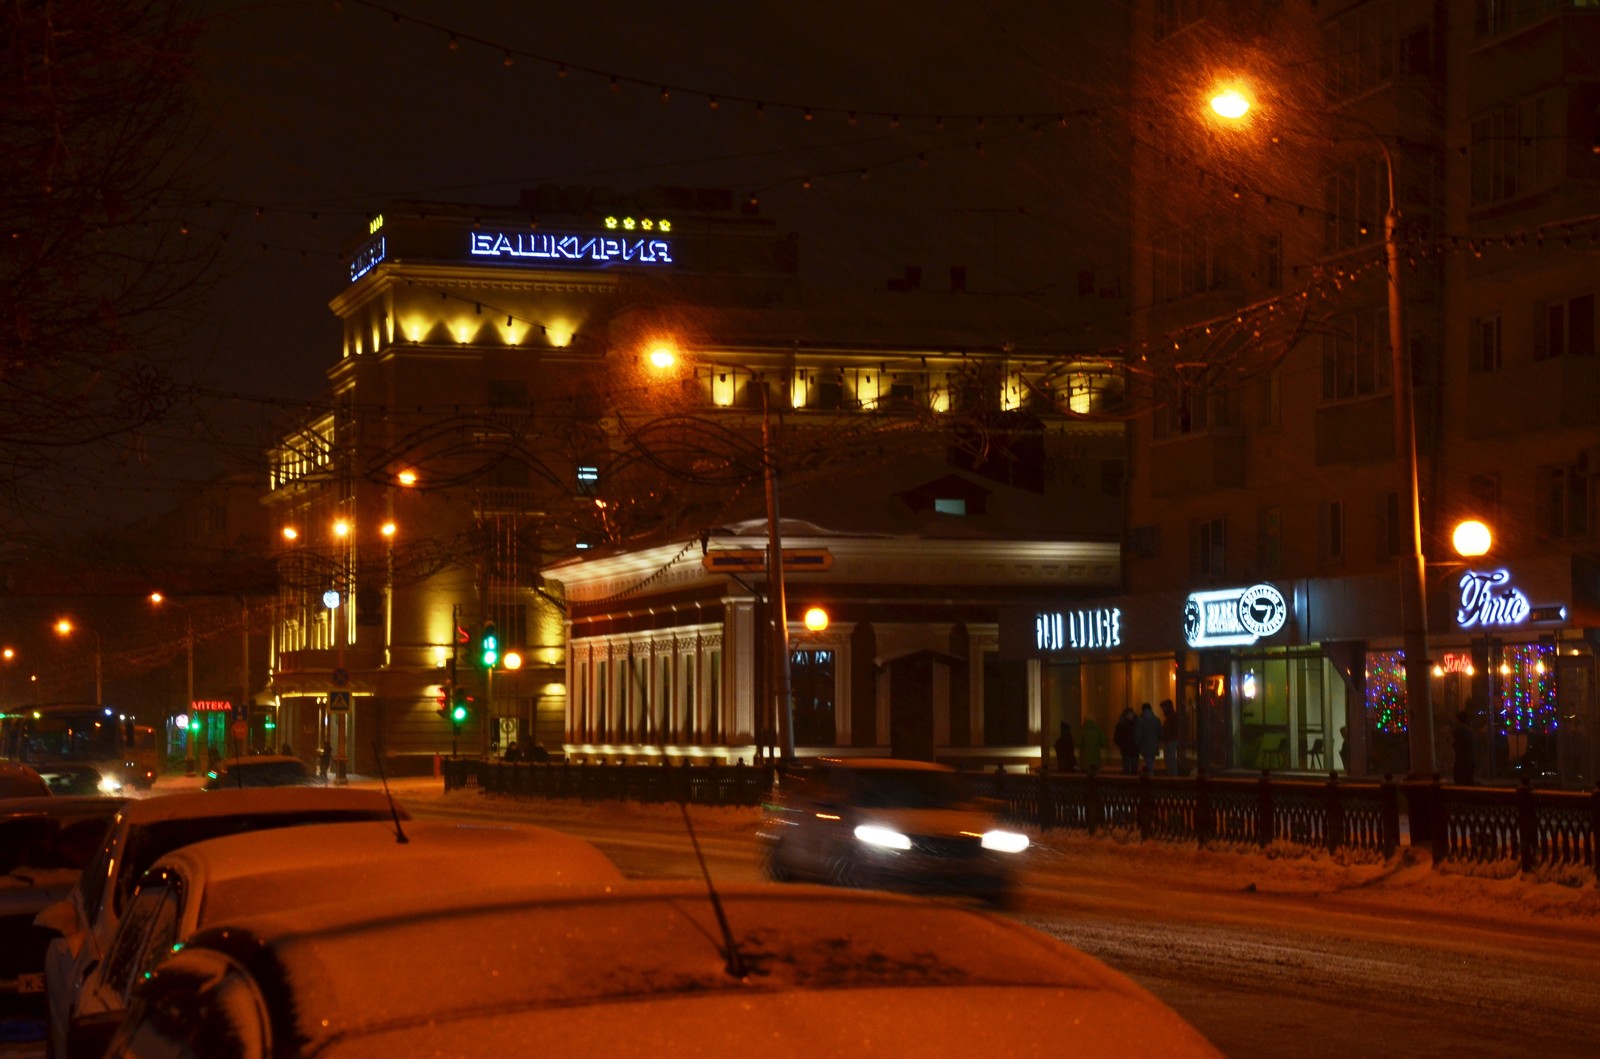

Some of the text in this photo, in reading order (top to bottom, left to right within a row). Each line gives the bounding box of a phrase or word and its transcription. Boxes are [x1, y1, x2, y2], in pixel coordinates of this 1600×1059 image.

[470, 231, 673, 263] БАШКИРИЯ
[1457, 569, 1529, 627] Tinto
[192, 699, 233, 711] АПТЕКА
